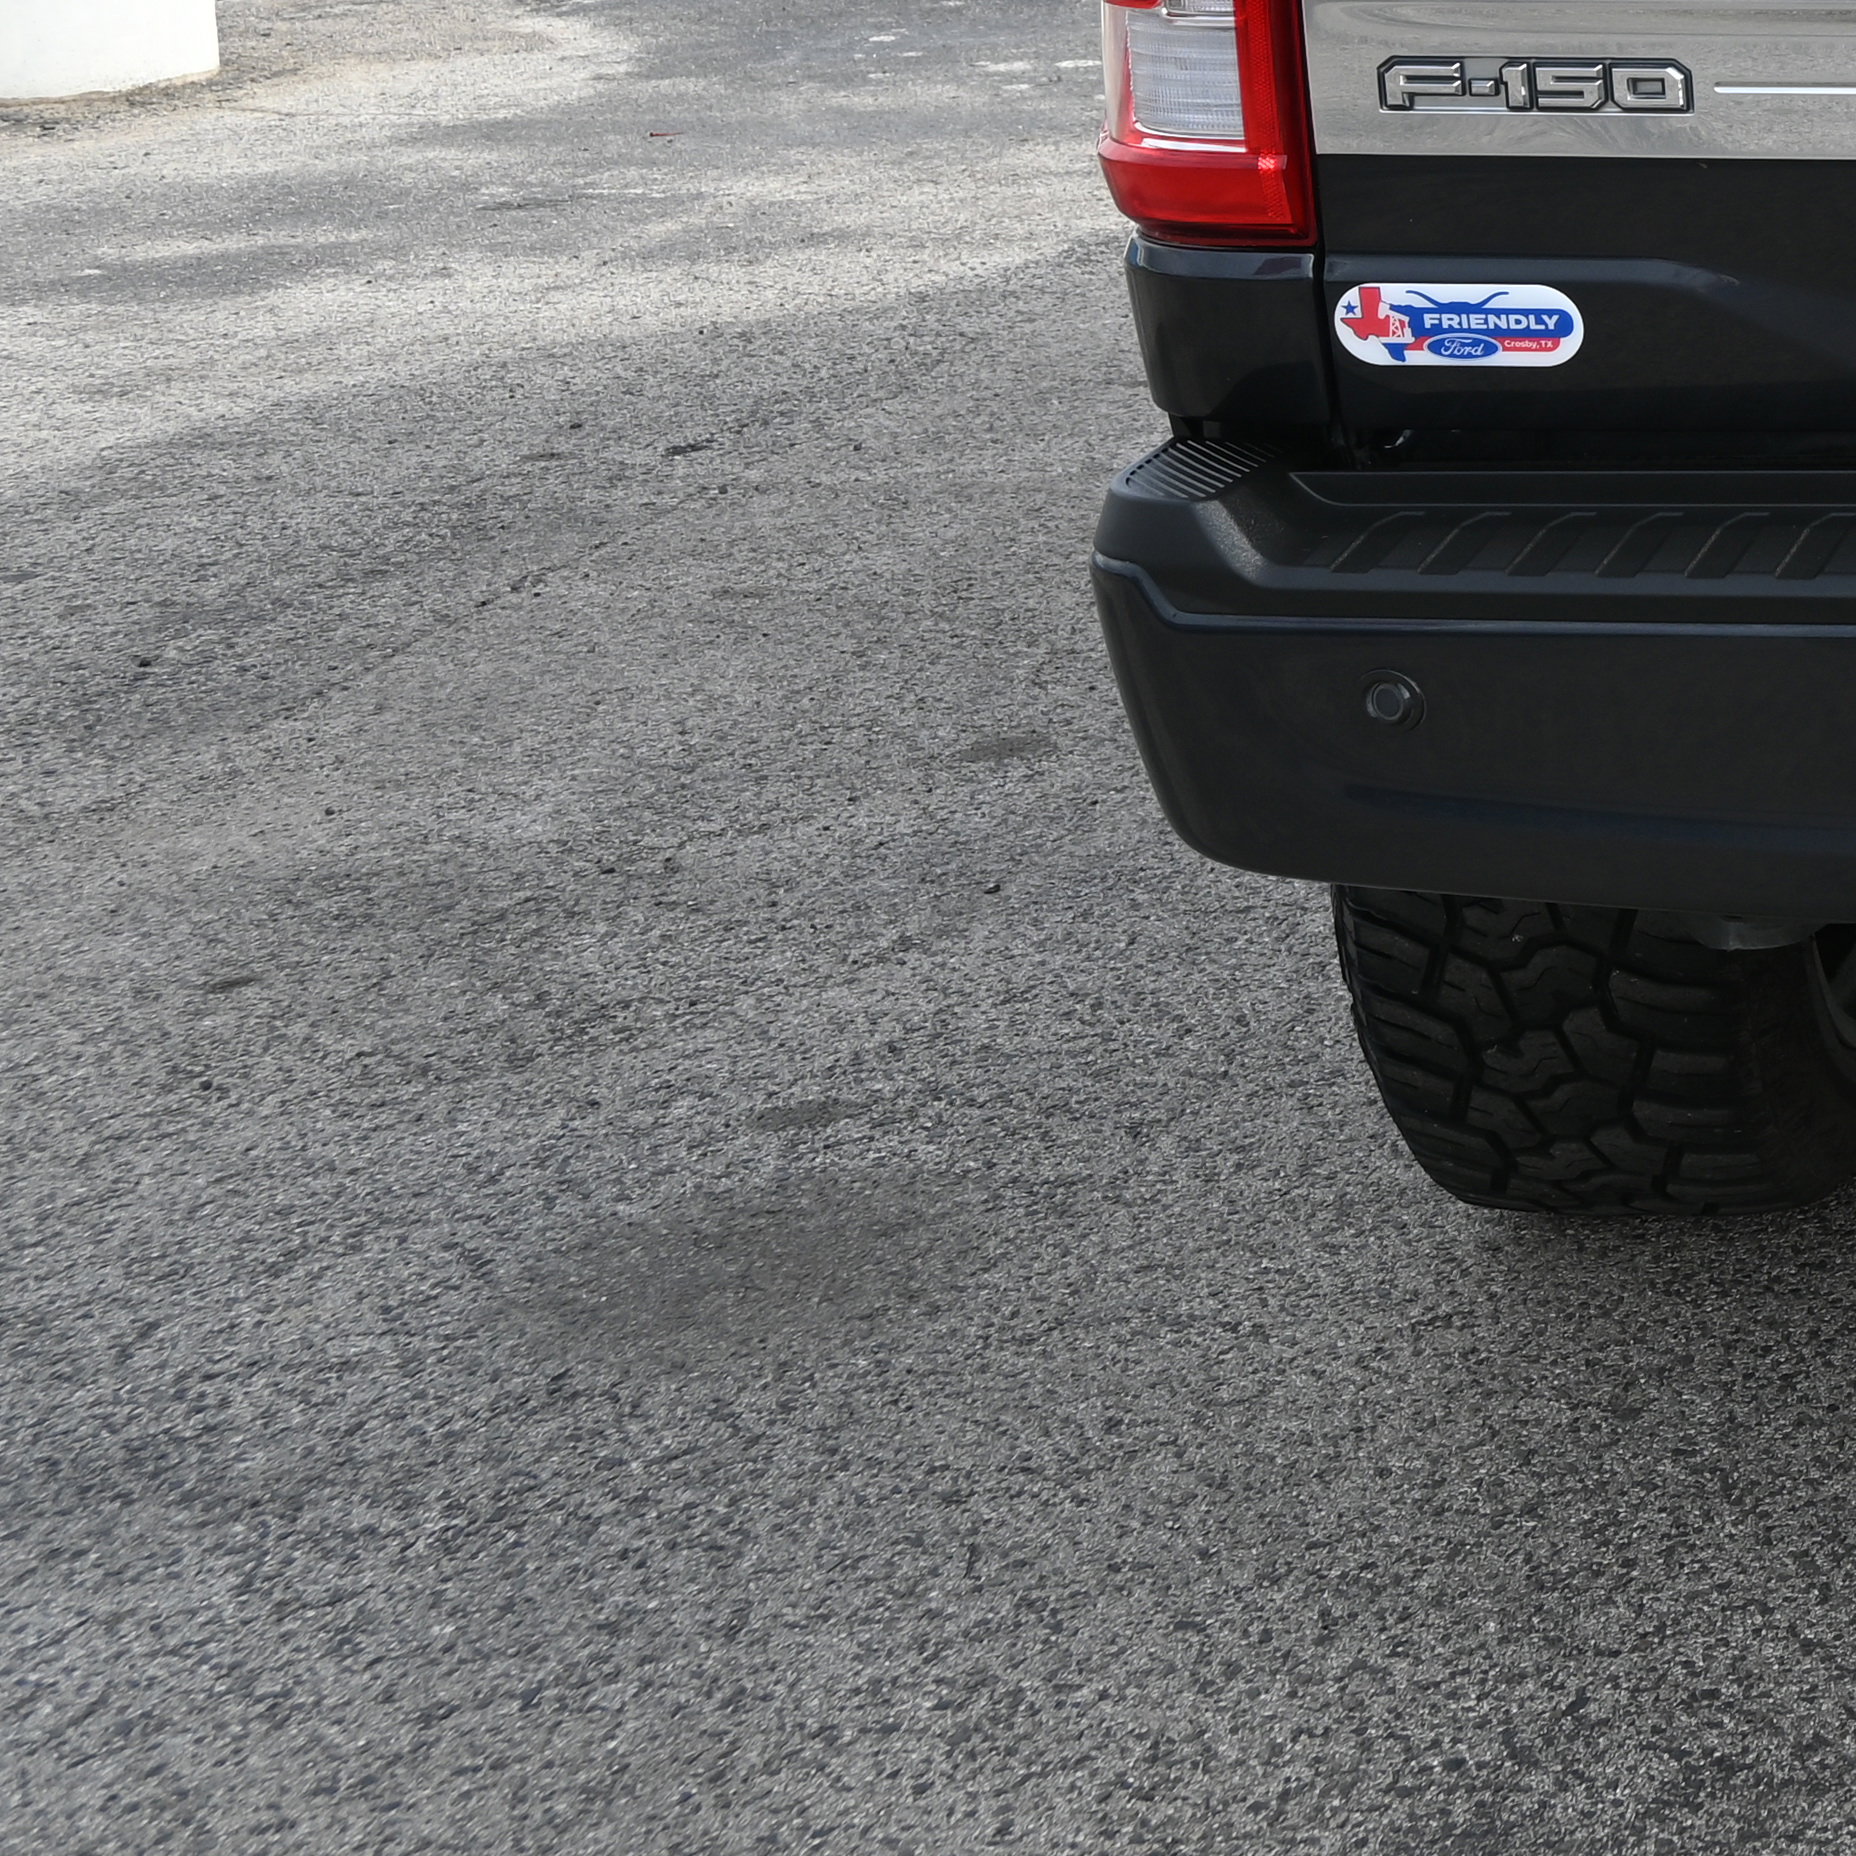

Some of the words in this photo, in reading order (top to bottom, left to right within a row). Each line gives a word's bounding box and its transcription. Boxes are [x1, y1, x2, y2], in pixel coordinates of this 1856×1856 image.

[1379, 56, 1692, 111] F-150
[1423, 313, 1560, 330] FRIENDLY
[1440, 337, 1485, 356] Ford
